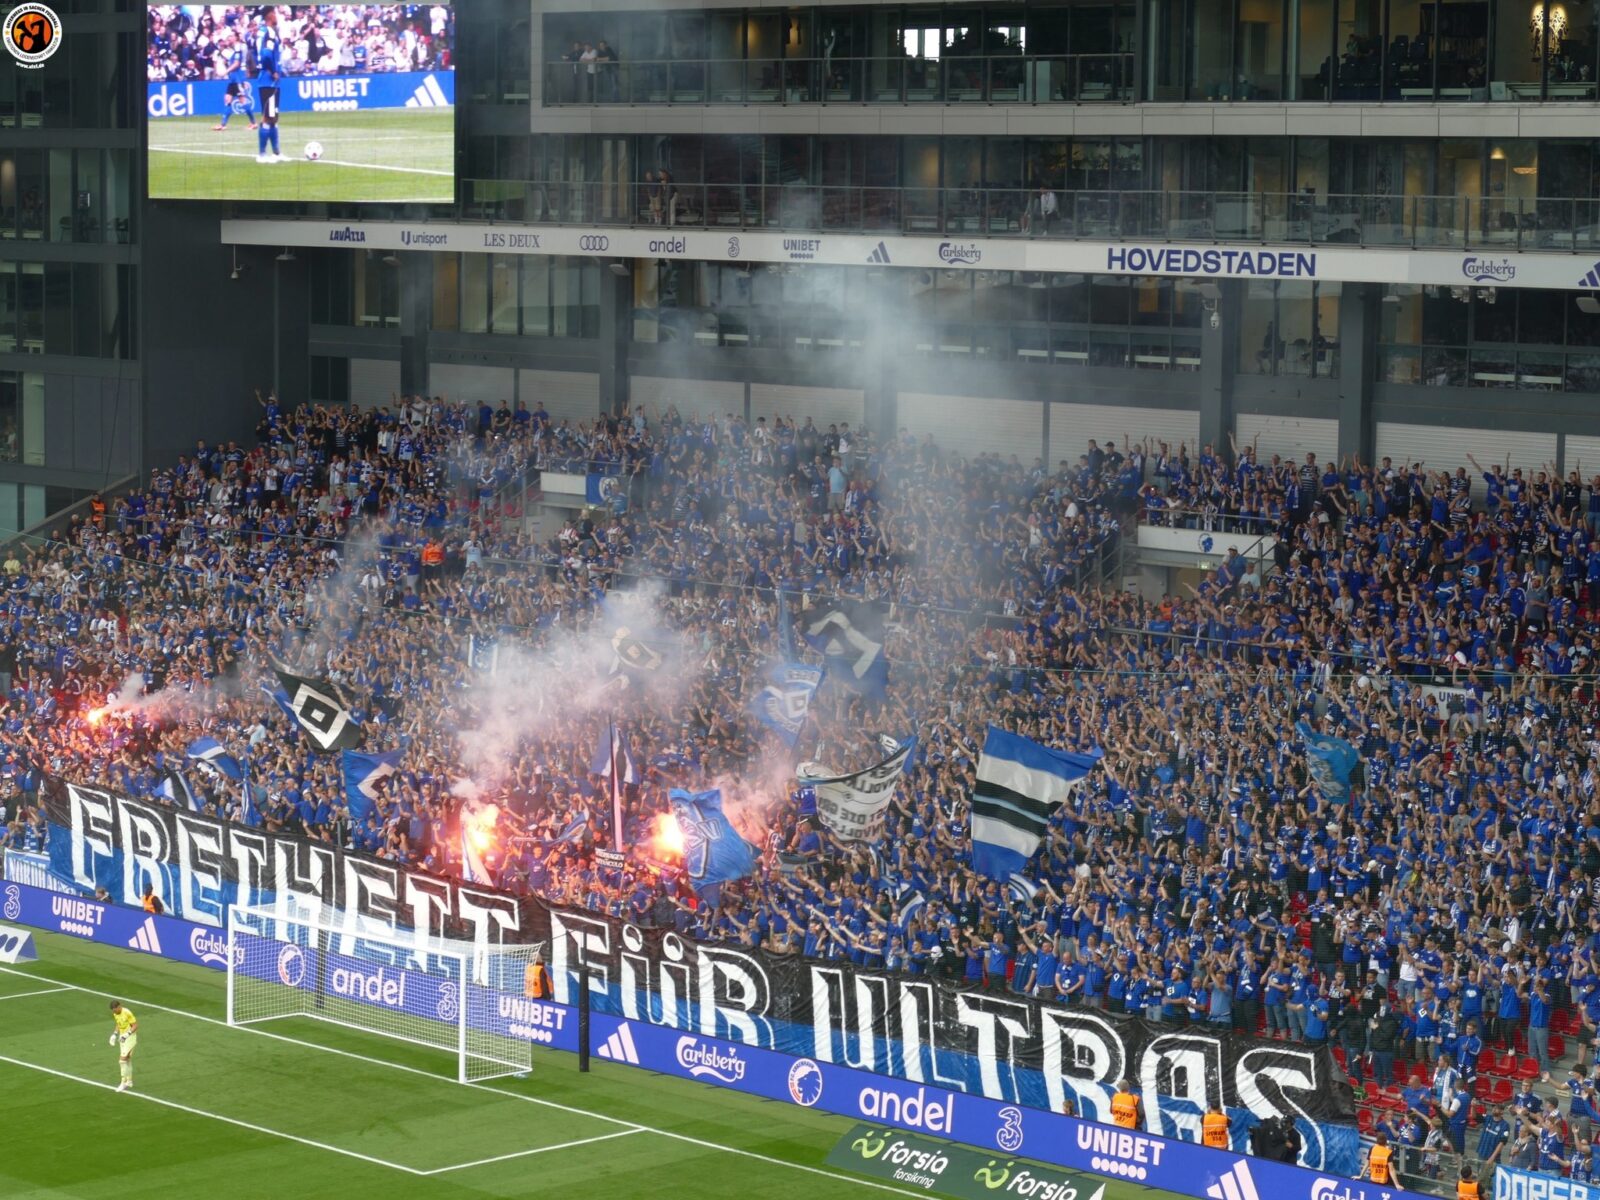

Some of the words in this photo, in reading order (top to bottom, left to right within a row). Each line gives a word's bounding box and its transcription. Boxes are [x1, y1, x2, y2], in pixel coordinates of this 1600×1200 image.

[298, 78, 370, 99] UNIBET
[329, 226, 366, 242] LAVAZZA
[412, 231, 448, 247] unisport
[484, 233, 506, 247] LES
[509, 234, 541, 248] DEUX
[649, 236, 686, 253] andel
[783, 239, 821, 252] UNIBET
[938, 242, 981, 264] Carlsberg
[1107, 247, 1316, 277] HOVEDSTADEN
[1462, 257, 1516, 280] Carlsberg
[52, 896, 105, 925] UNIBET
[332, 967, 406, 1007] andel
[498, 995, 567, 1030] UNIBET
[675, 1035, 746, 1079] Carlsberg
[810, 965, 1327, 1173] ULTRAS
[858, 1086, 954, 1133] andel
[881, 1140, 949, 1175] forsia
[1076, 1124, 1166, 1166] UNIBET
[892, 1167, 936, 1189] forsikring
